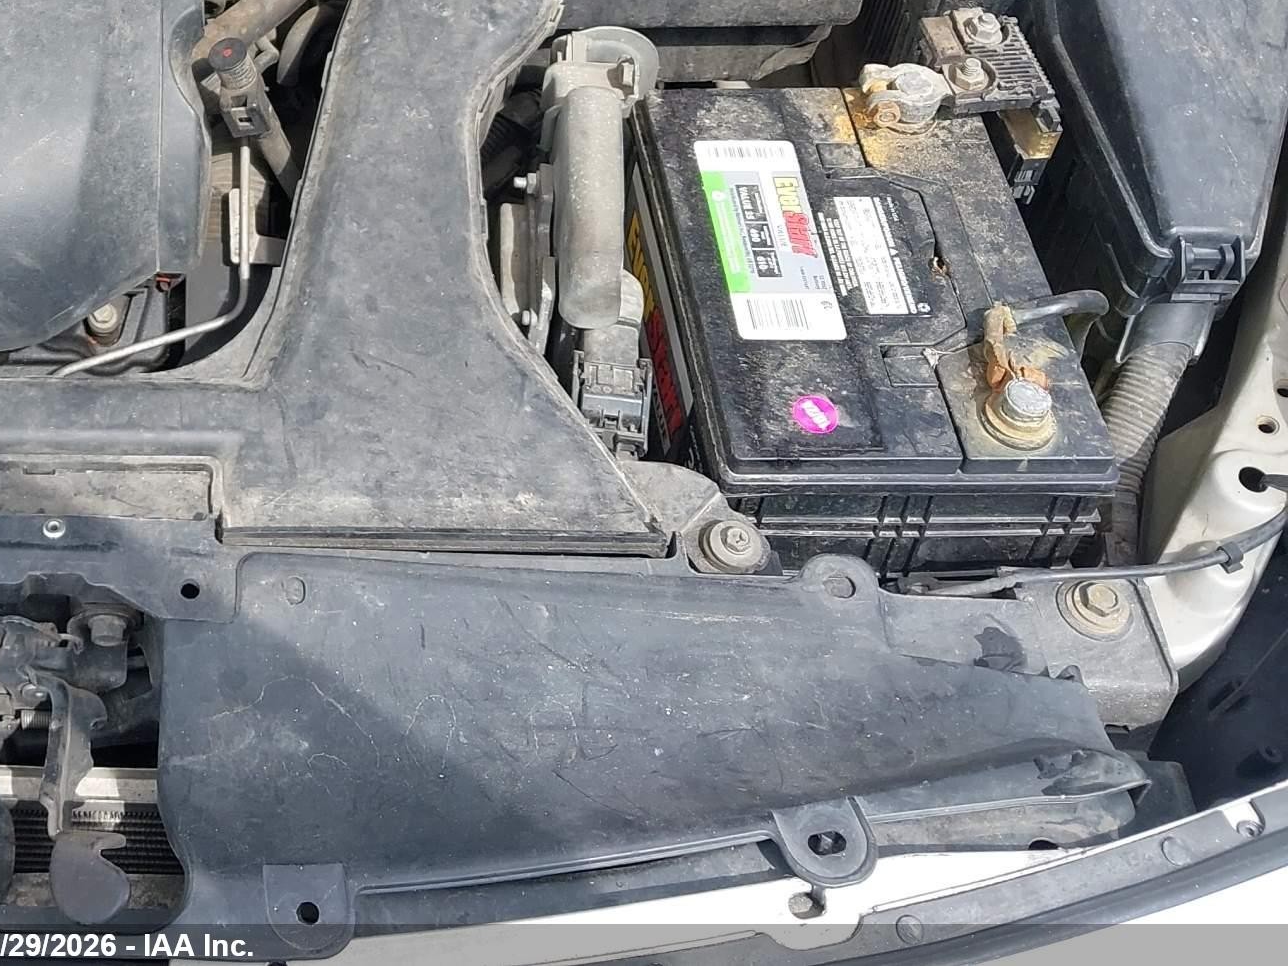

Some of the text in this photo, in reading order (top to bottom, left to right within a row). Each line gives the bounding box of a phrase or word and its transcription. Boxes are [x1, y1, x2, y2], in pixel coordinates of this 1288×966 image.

[739, 187, 752, 211] VALUE
[773, 177, 818, 258] EverStart
[757, 255, 768, 270] 610
